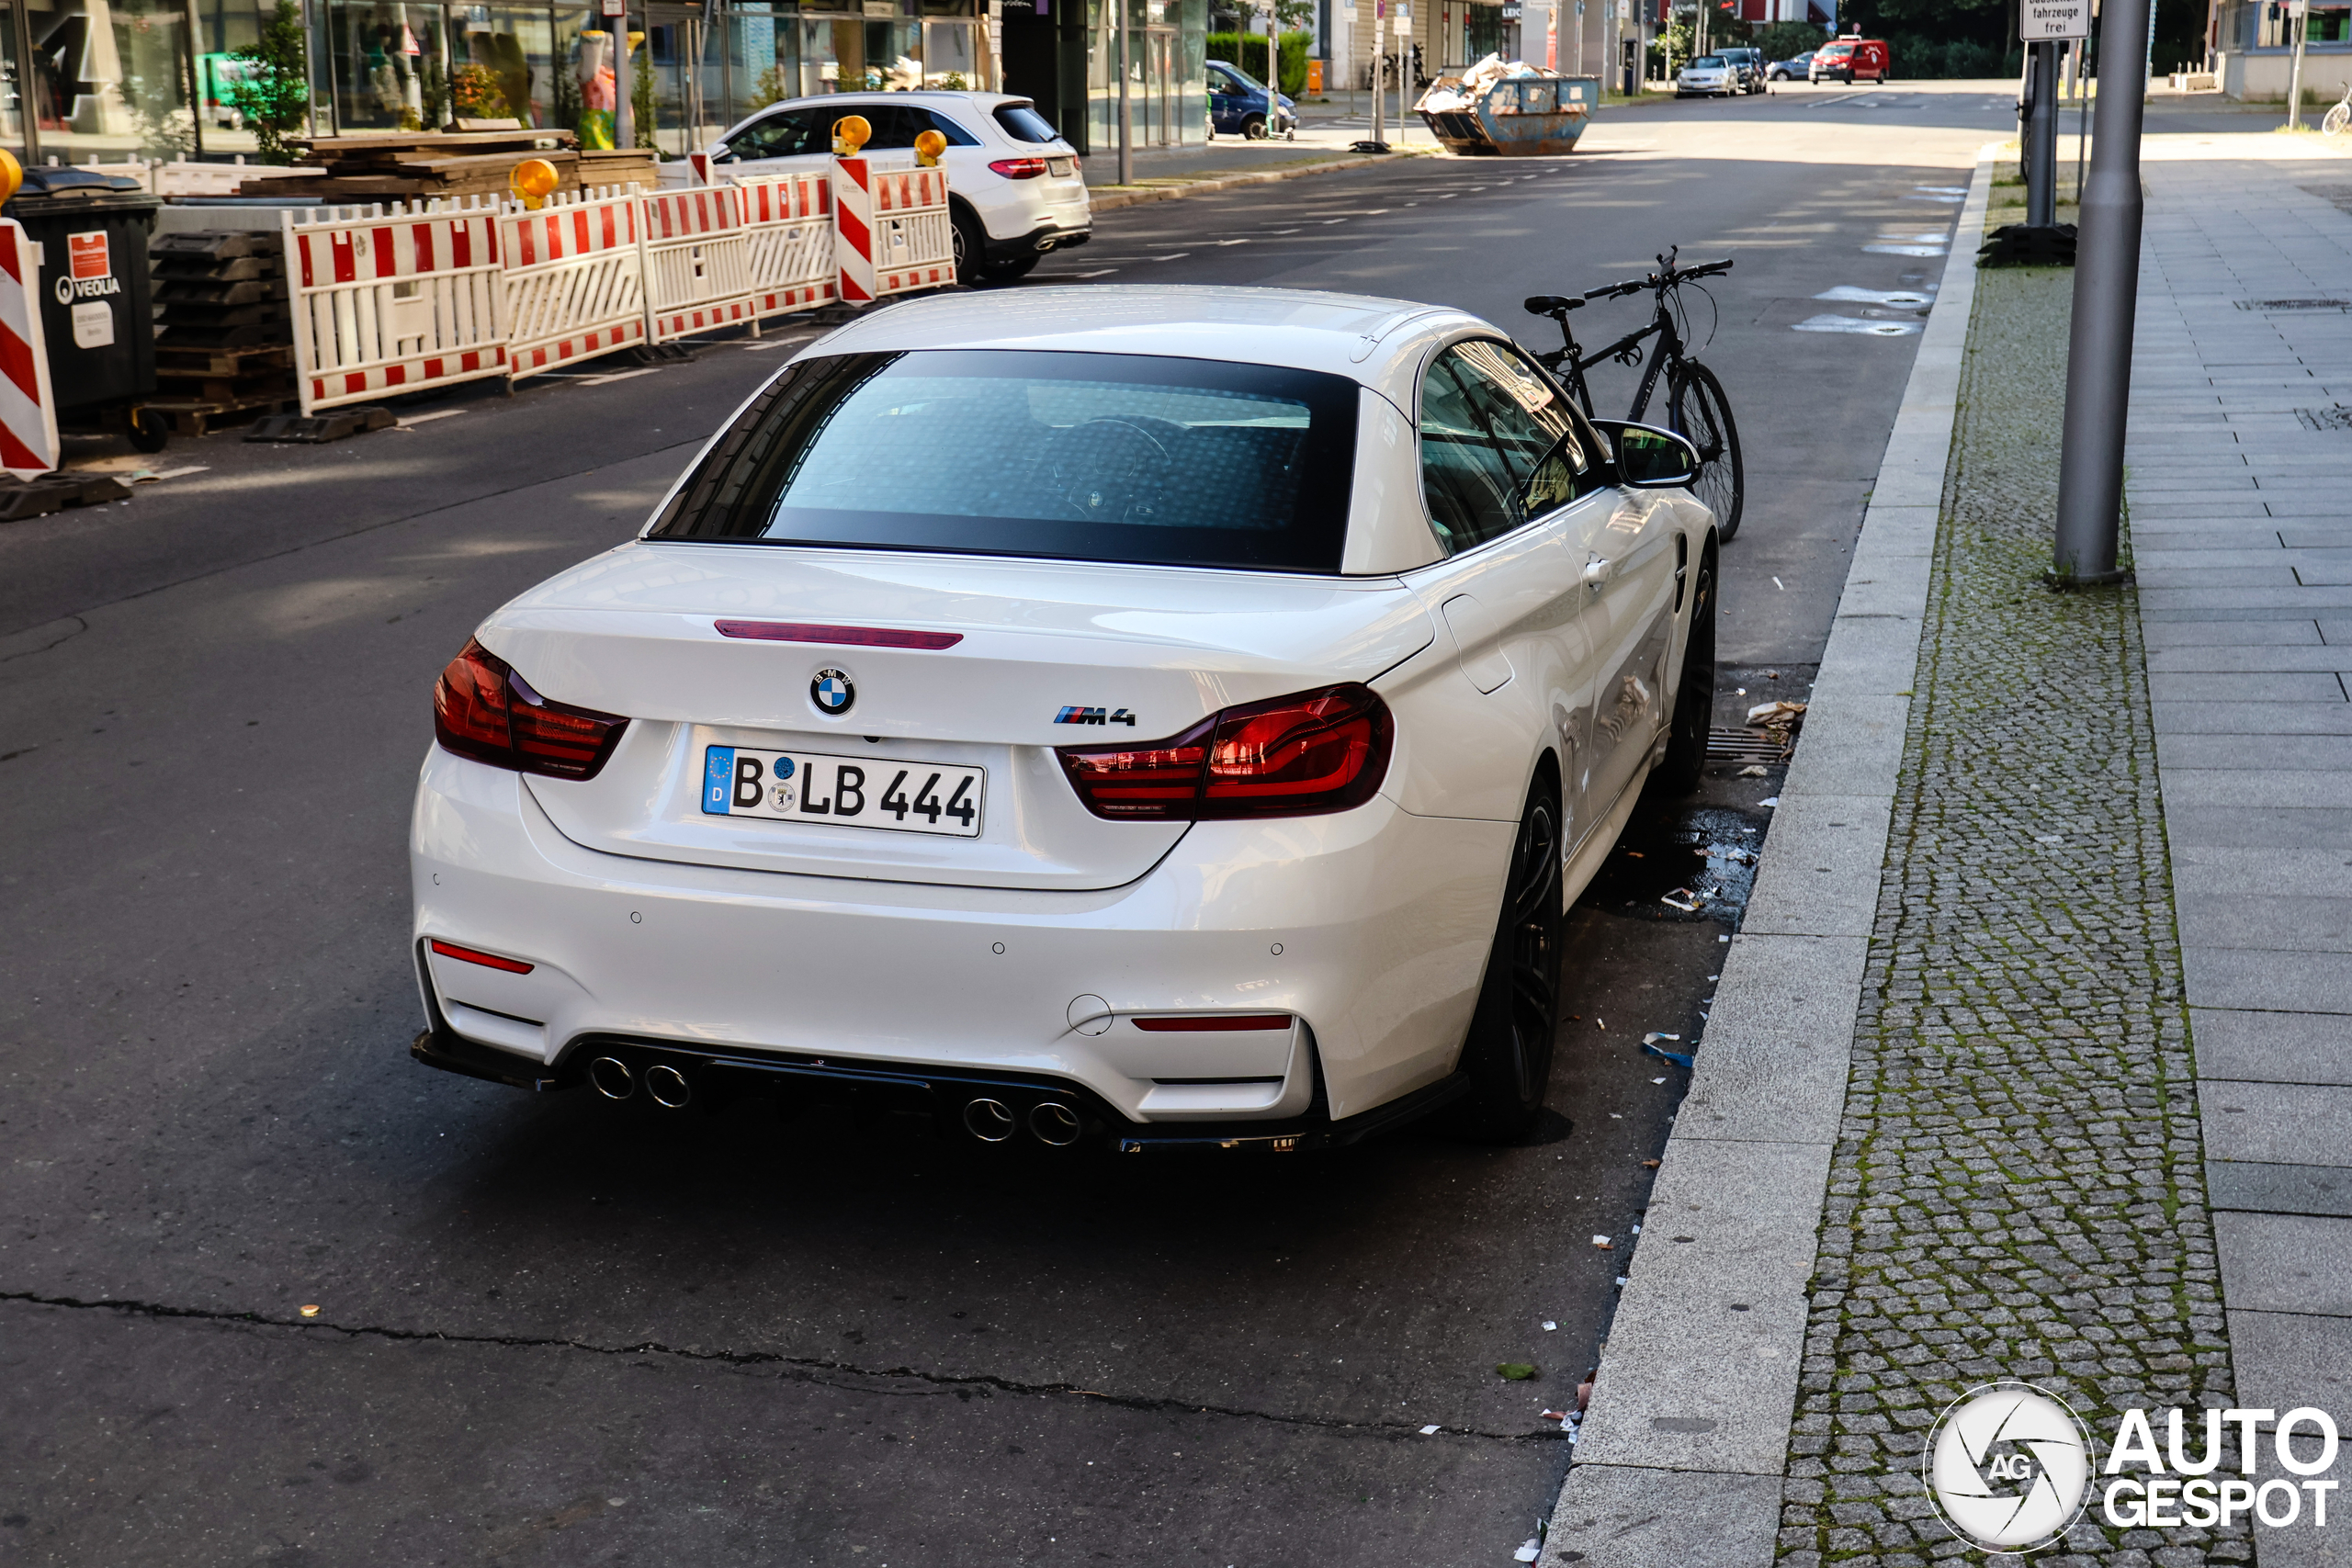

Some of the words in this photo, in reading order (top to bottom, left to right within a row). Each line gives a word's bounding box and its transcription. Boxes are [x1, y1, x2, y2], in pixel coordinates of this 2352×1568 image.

[2033, 7, 2079, 19] fahrzeuge
[2045, 20, 2066, 33] frei
[75, 277, 121, 298] VEOLIA
[814, 669, 852, 686] BMW
[1054, 705, 1136, 727] M4
[712, 787, 722, 802] D
[733, 757, 763, 808] B
[800, 762, 865, 817] LB
[880, 770, 975, 827] 444
